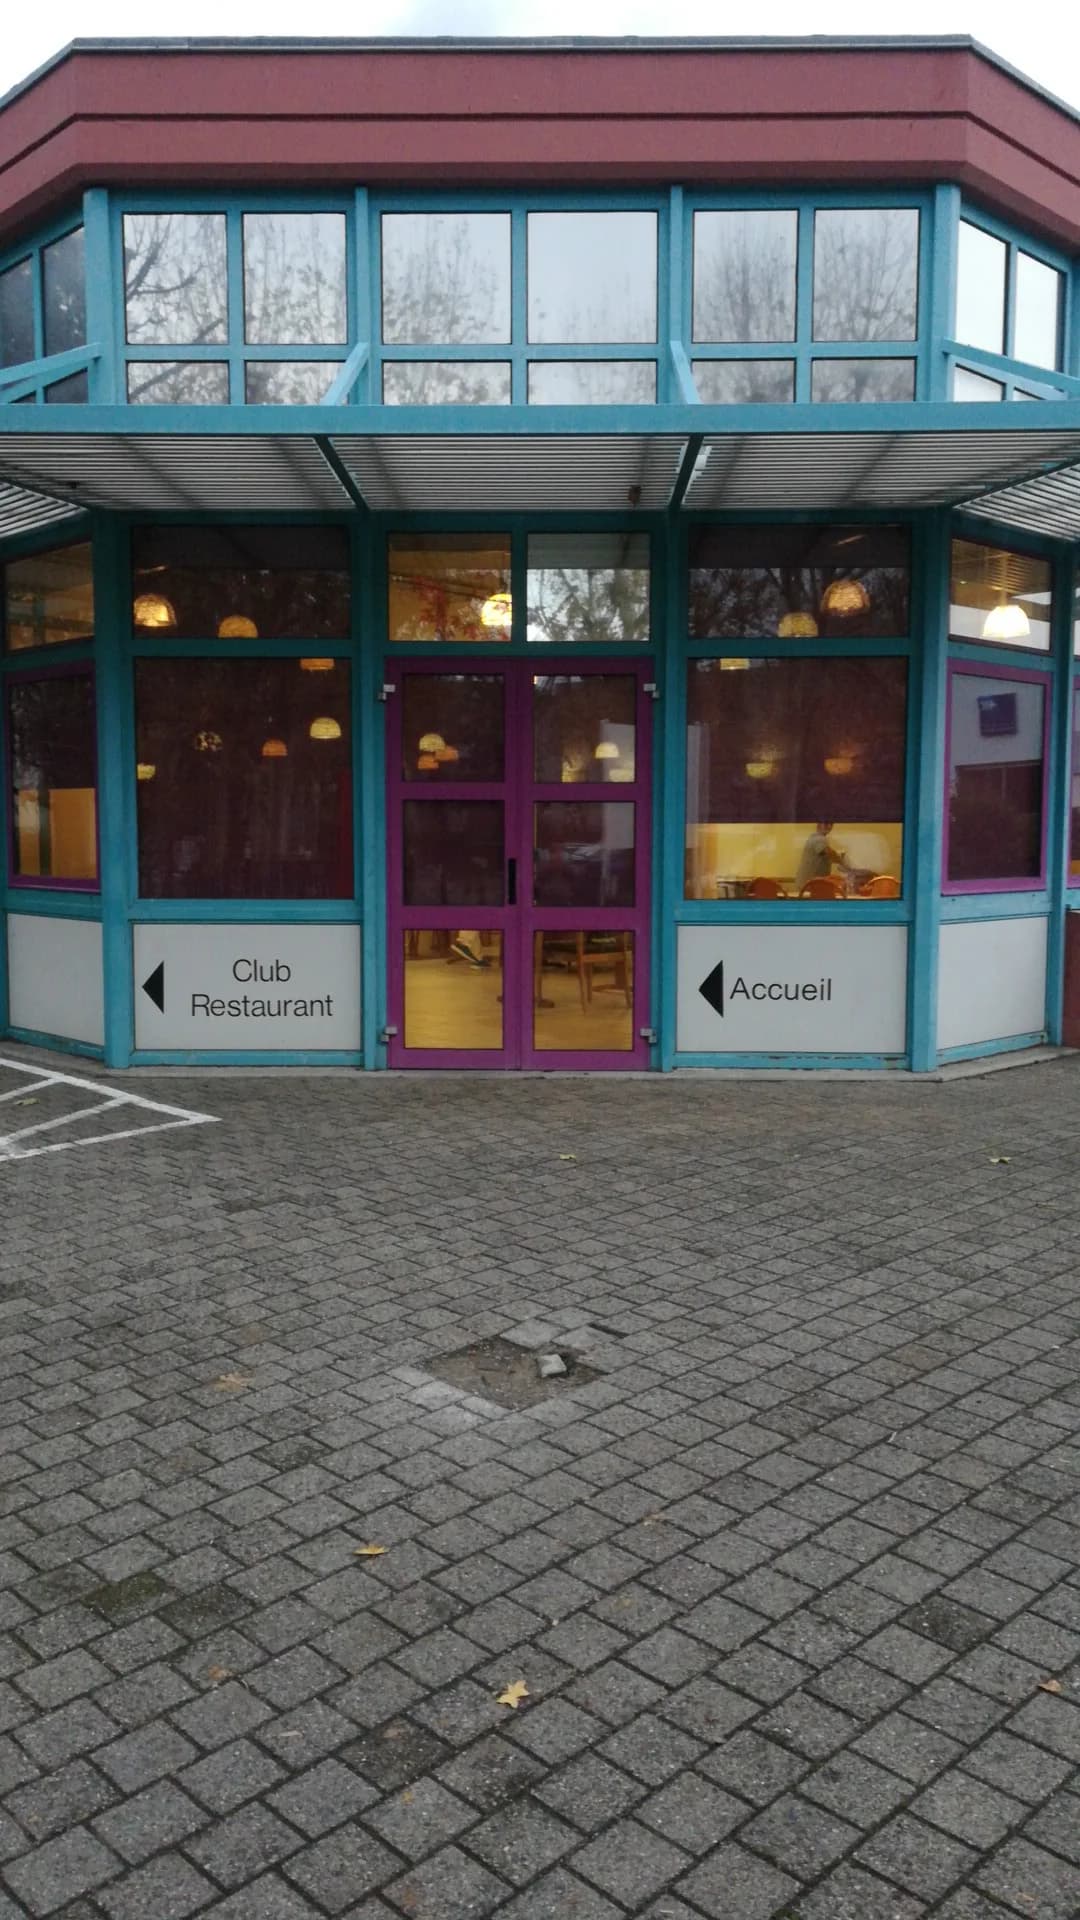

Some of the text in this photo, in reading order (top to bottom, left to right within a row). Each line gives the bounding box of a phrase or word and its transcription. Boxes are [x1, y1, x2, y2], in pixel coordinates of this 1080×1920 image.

[232, 958, 291, 983] Club
[729, 977, 832, 1001] Accueil
[191, 993, 333, 1018] Restaurant
